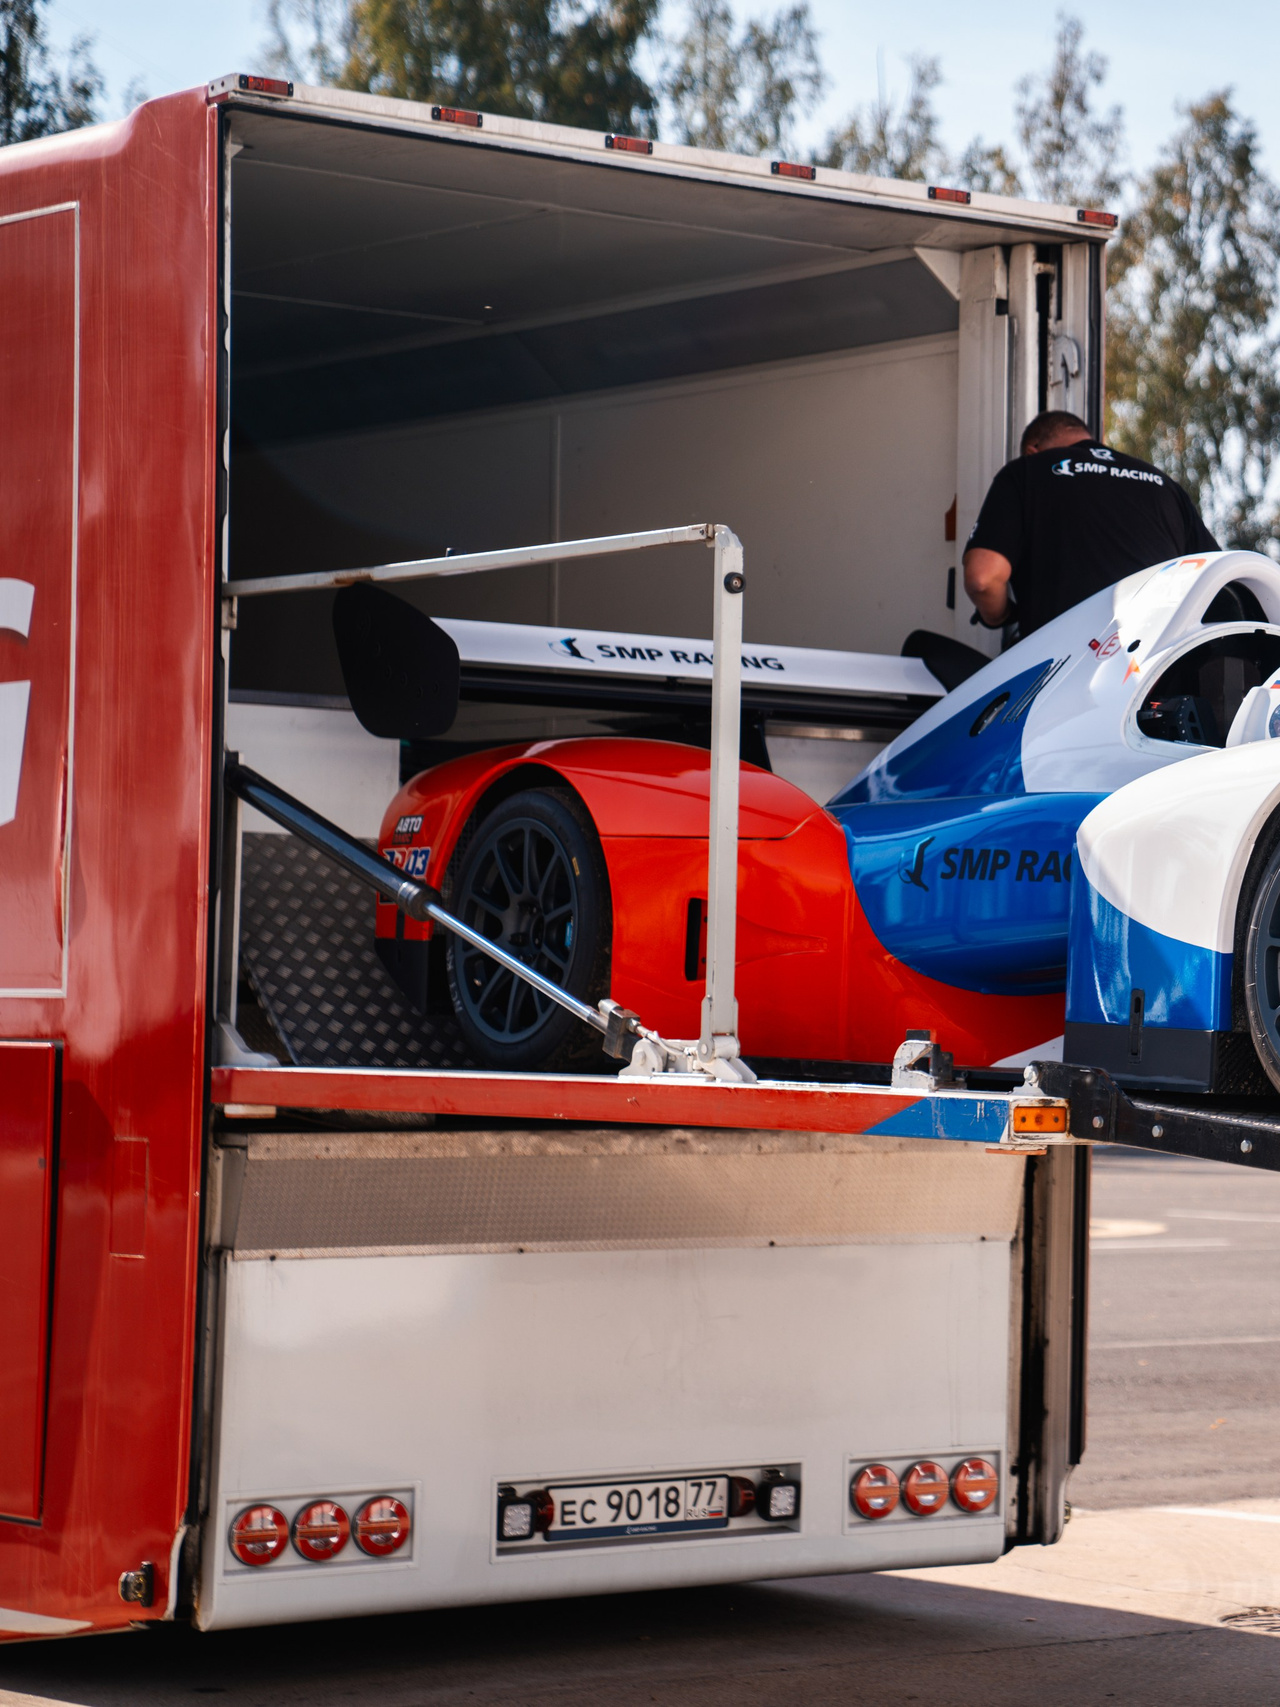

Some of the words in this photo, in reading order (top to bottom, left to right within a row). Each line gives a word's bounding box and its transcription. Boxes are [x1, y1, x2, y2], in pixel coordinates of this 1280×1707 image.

[1074, 462, 1107, 474] SMP
[1110, 467, 1164, 486] RACING
[596, 644, 664, 662] SMP
[669, 649, 785, 671] RANG
[396, 816, 423, 832] АВТО
[940, 847, 1010, 881] SMP
[560, 1499, 597, 1526] EC
[606, 1486, 681, 1523] 9018
[690, 1480, 717, 1507] 77
[687, 1507, 708, 1519] RUS
